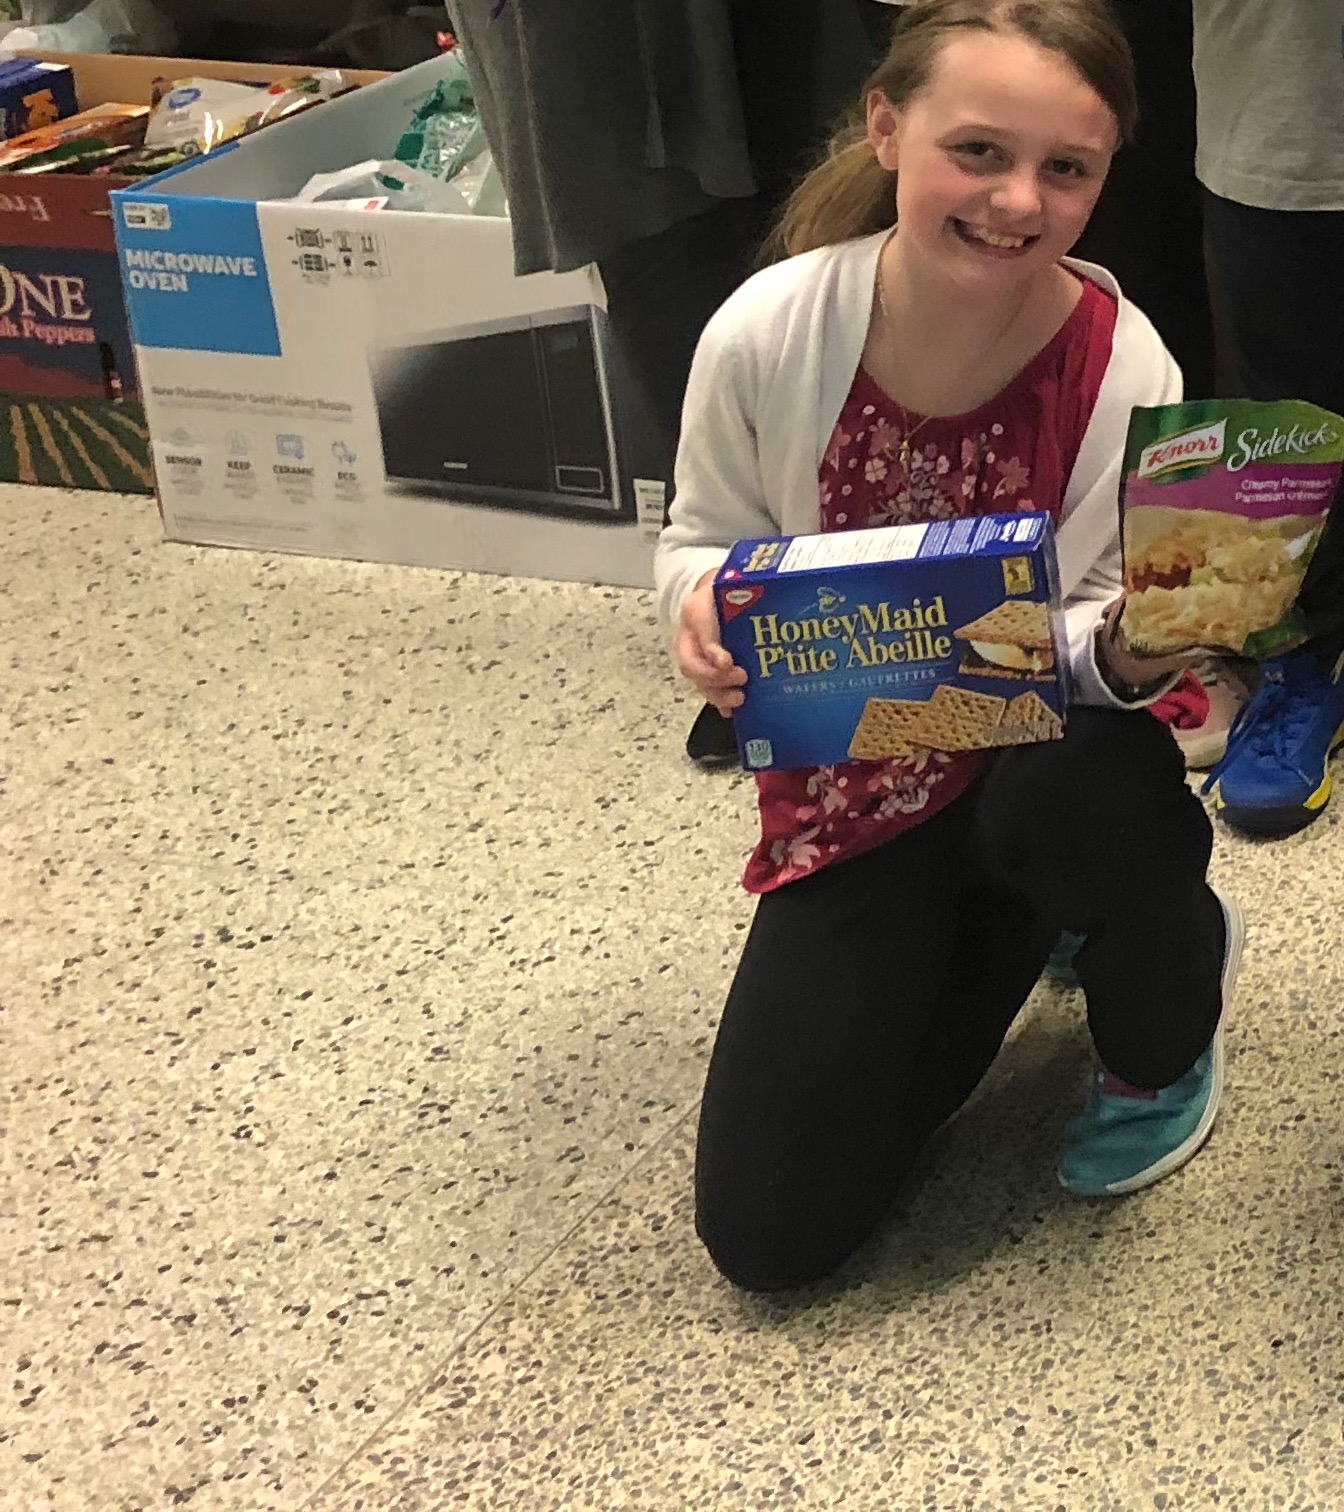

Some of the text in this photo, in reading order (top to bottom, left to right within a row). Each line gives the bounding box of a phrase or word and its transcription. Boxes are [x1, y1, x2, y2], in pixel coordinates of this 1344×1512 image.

[125, 249, 257, 276] MICROWAVE
[129, 270, 188, 292] OVEN
[1147, 434, 1220, 467] Knorr
[749, 594, 949, 647] HoneyMaid
[757, 629, 952, 678] P'tite Abeille
